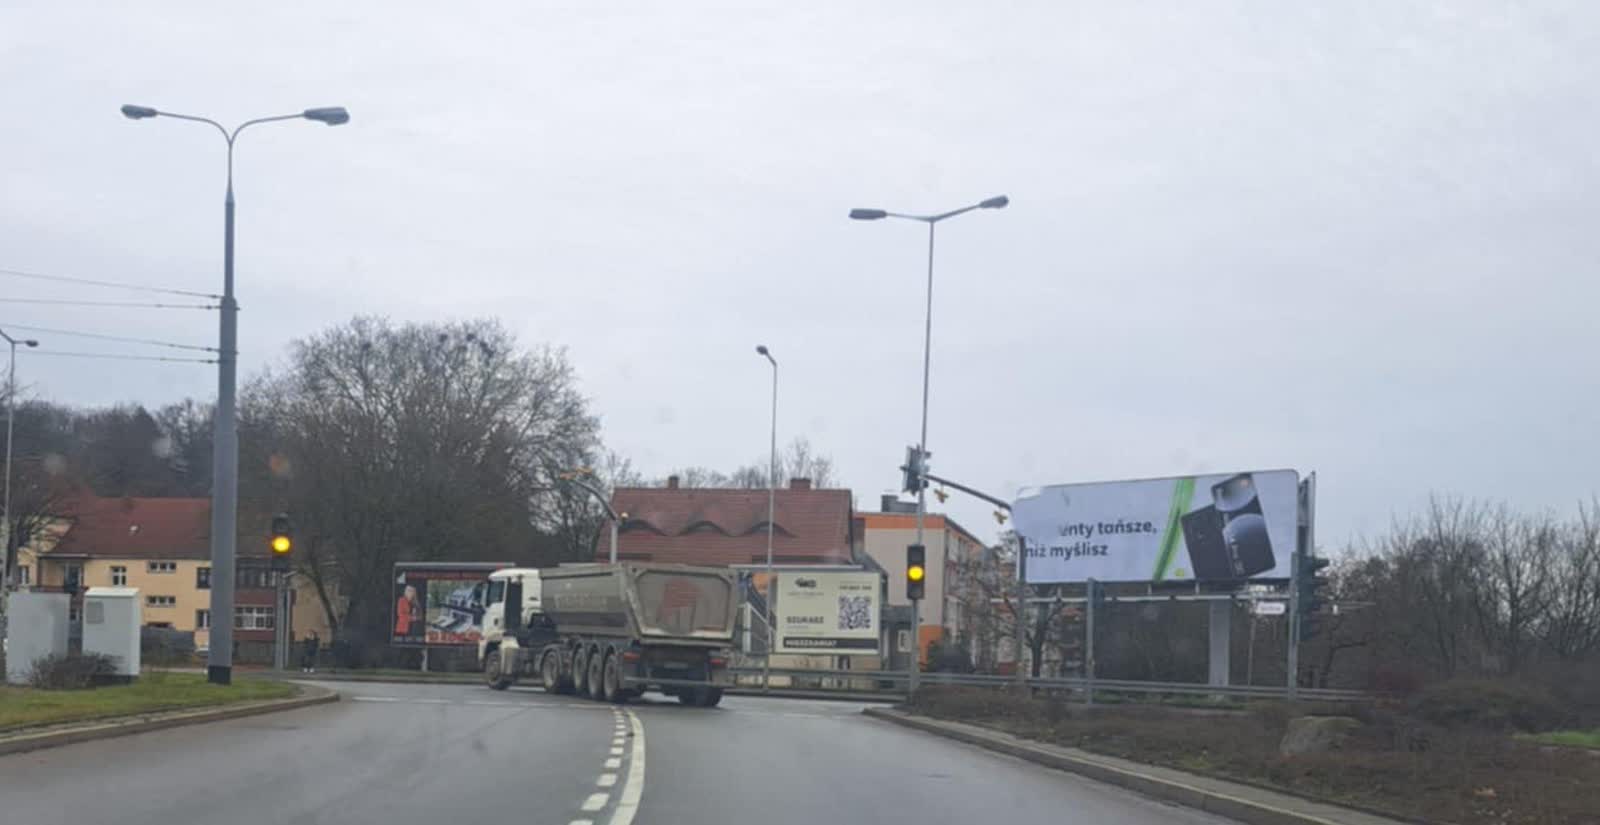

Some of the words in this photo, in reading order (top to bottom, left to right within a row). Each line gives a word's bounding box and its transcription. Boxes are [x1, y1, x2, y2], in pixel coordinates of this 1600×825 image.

[1097, 519, 1157, 535] tańsze,
[1024, 543, 1046, 558] niż
[1050, 541, 1108, 561] myślisz
